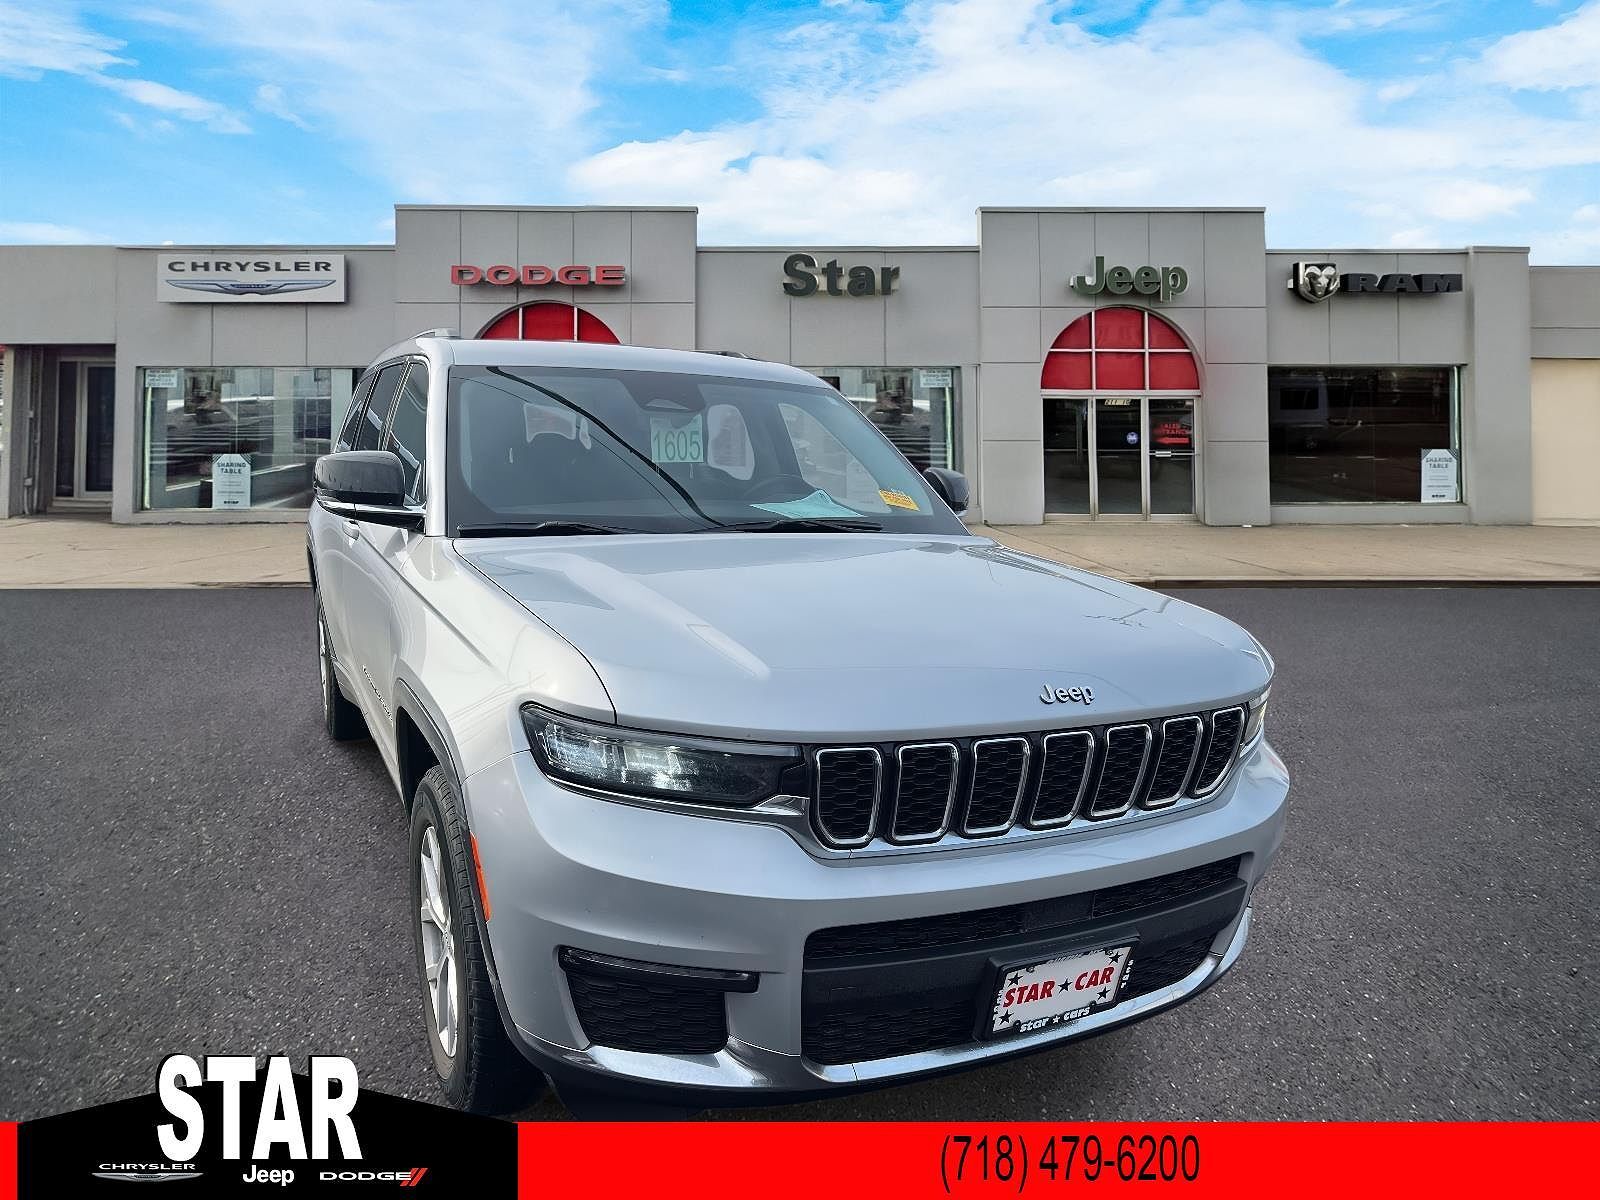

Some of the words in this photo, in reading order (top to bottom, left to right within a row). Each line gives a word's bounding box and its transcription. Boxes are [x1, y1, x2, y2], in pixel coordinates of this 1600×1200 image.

[167, 261, 332, 272] CHRYSLER
[451, 265, 626, 286] DODGE
[783, 253, 900, 297] Star
[1070, 256, 1189, 302] Jeep
[1341, 273, 1463, 293] RAM
[654, 430, 701, 460] 1605
[1039, 684, 1095, 705] Jeep
[1003, 980, 1056, 1008] STAR
[1074, 966, 1115, 991] CAR
[1019, 1017, 1050, 1033] star
[1063, 1006, 1091, 1021] cars
